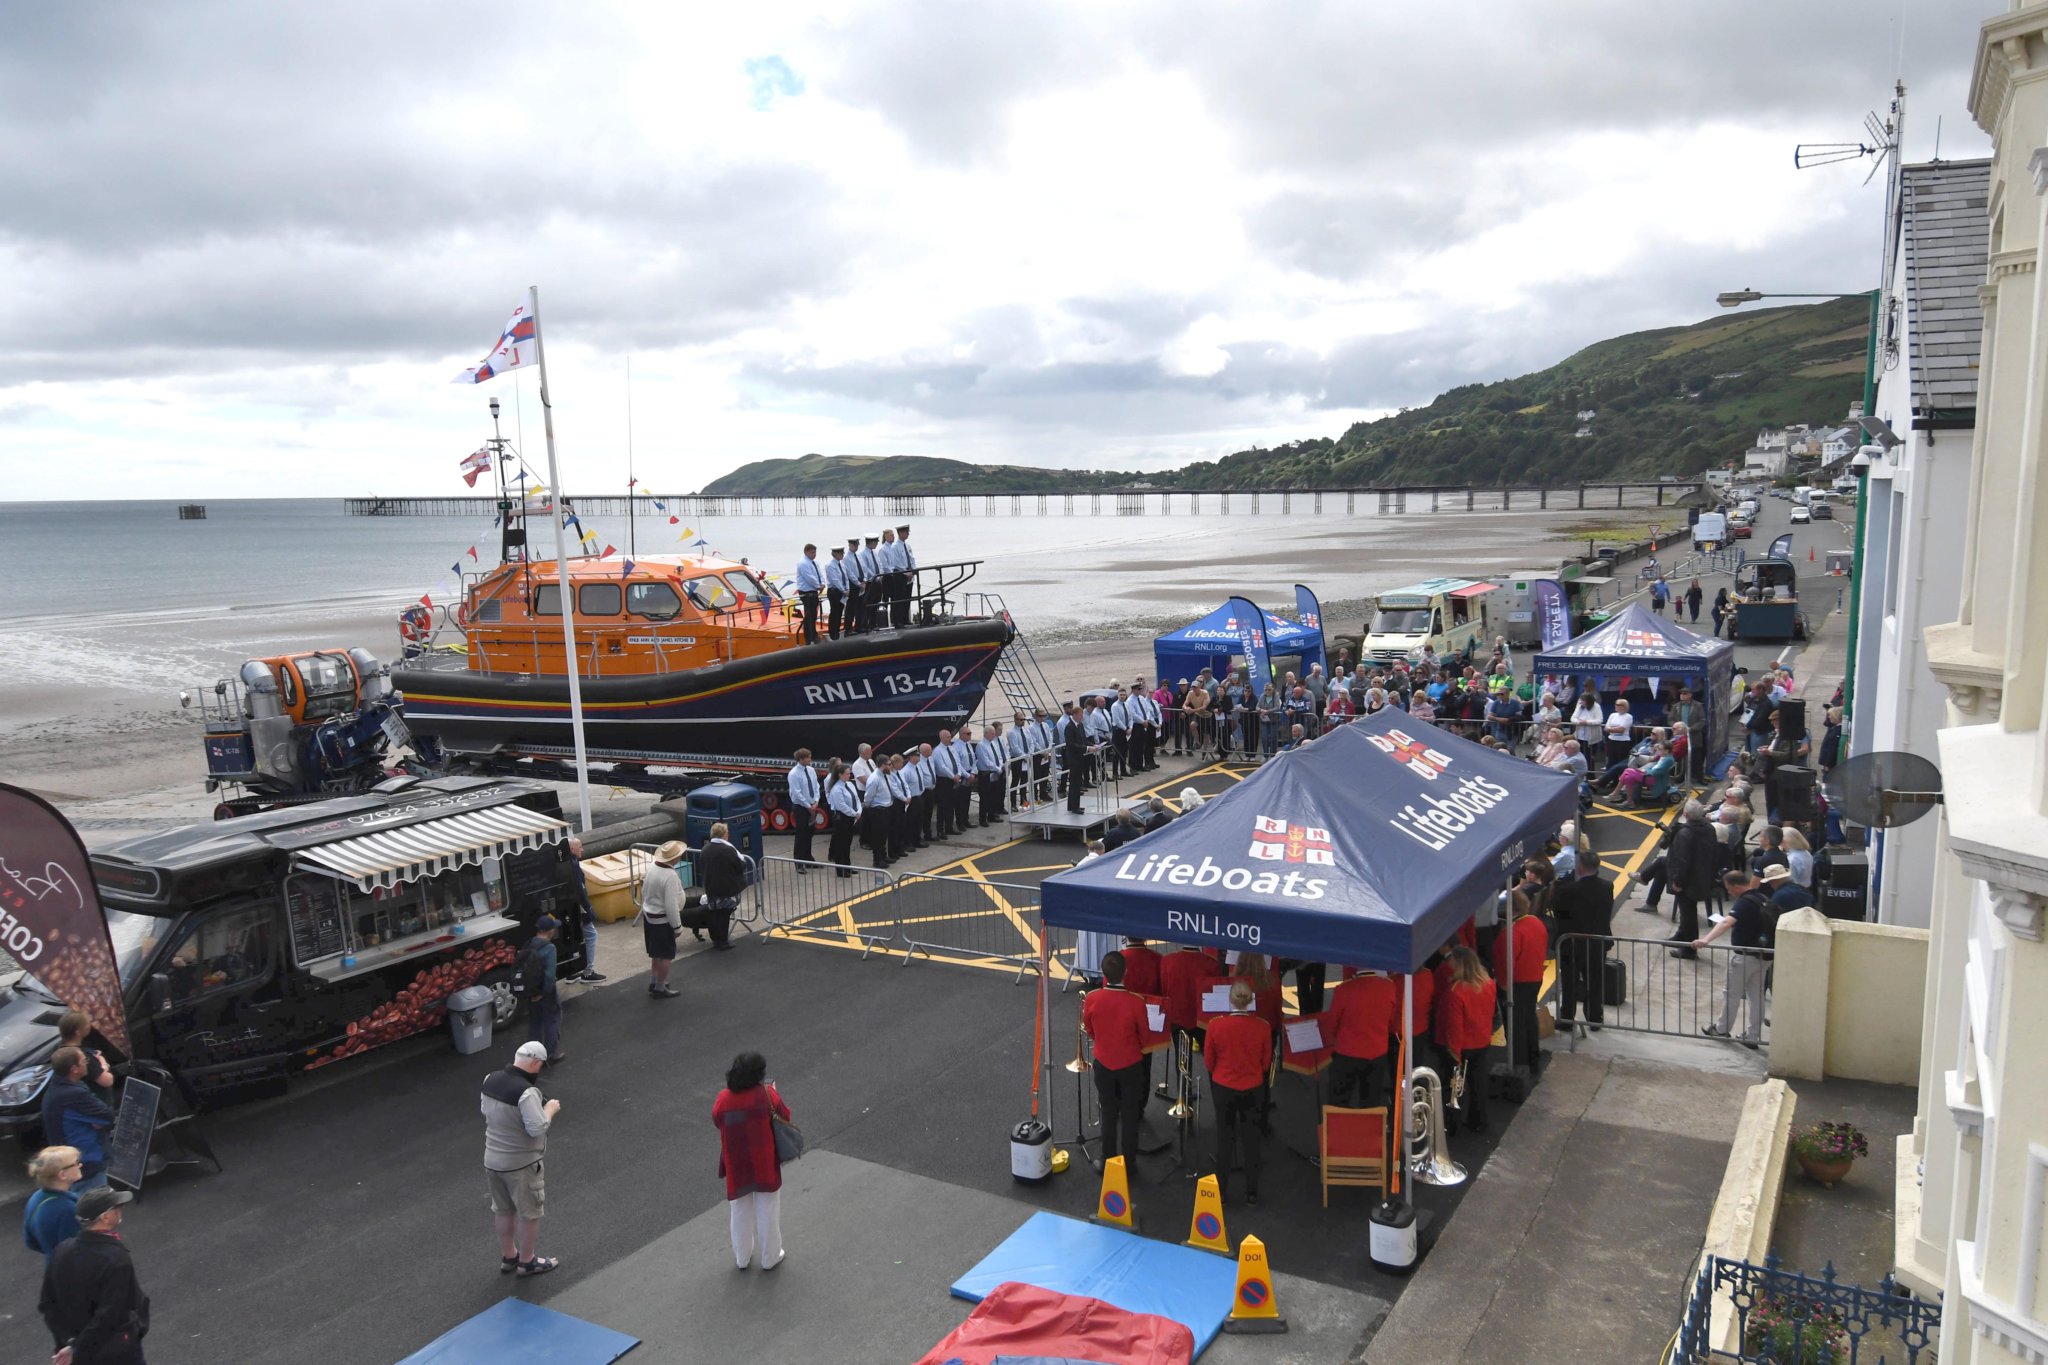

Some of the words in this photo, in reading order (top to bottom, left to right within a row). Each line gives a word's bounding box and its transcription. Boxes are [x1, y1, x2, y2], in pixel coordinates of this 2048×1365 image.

[1184, 629, 1241, 639] Lifeboat
[1195, 642, 1228, 652] RNLI.org
[1566, 645, 1666, 657] Lifeboats
[1537, 661, 1557, 669] FREE
[1574, 662, 1602, 670] SAFETY
[803, 678, 874, 705] RNLI
[883, 665, 961, 695] 13-42
[347, 805, 418, 825] 07624
[424, 786, 506, 809] 332332
[1389, 775, 1510, 851] Lifeboats
[1115, 853, 1328, 900] Lifeboats
[1827, 889, 1857, 898] EVENT
[1167, 910, 1261, 946] RNLI.org
[1200, 1189, 1215, 1199] DOI
[1245, 1253, 1262, 1263] DOI
